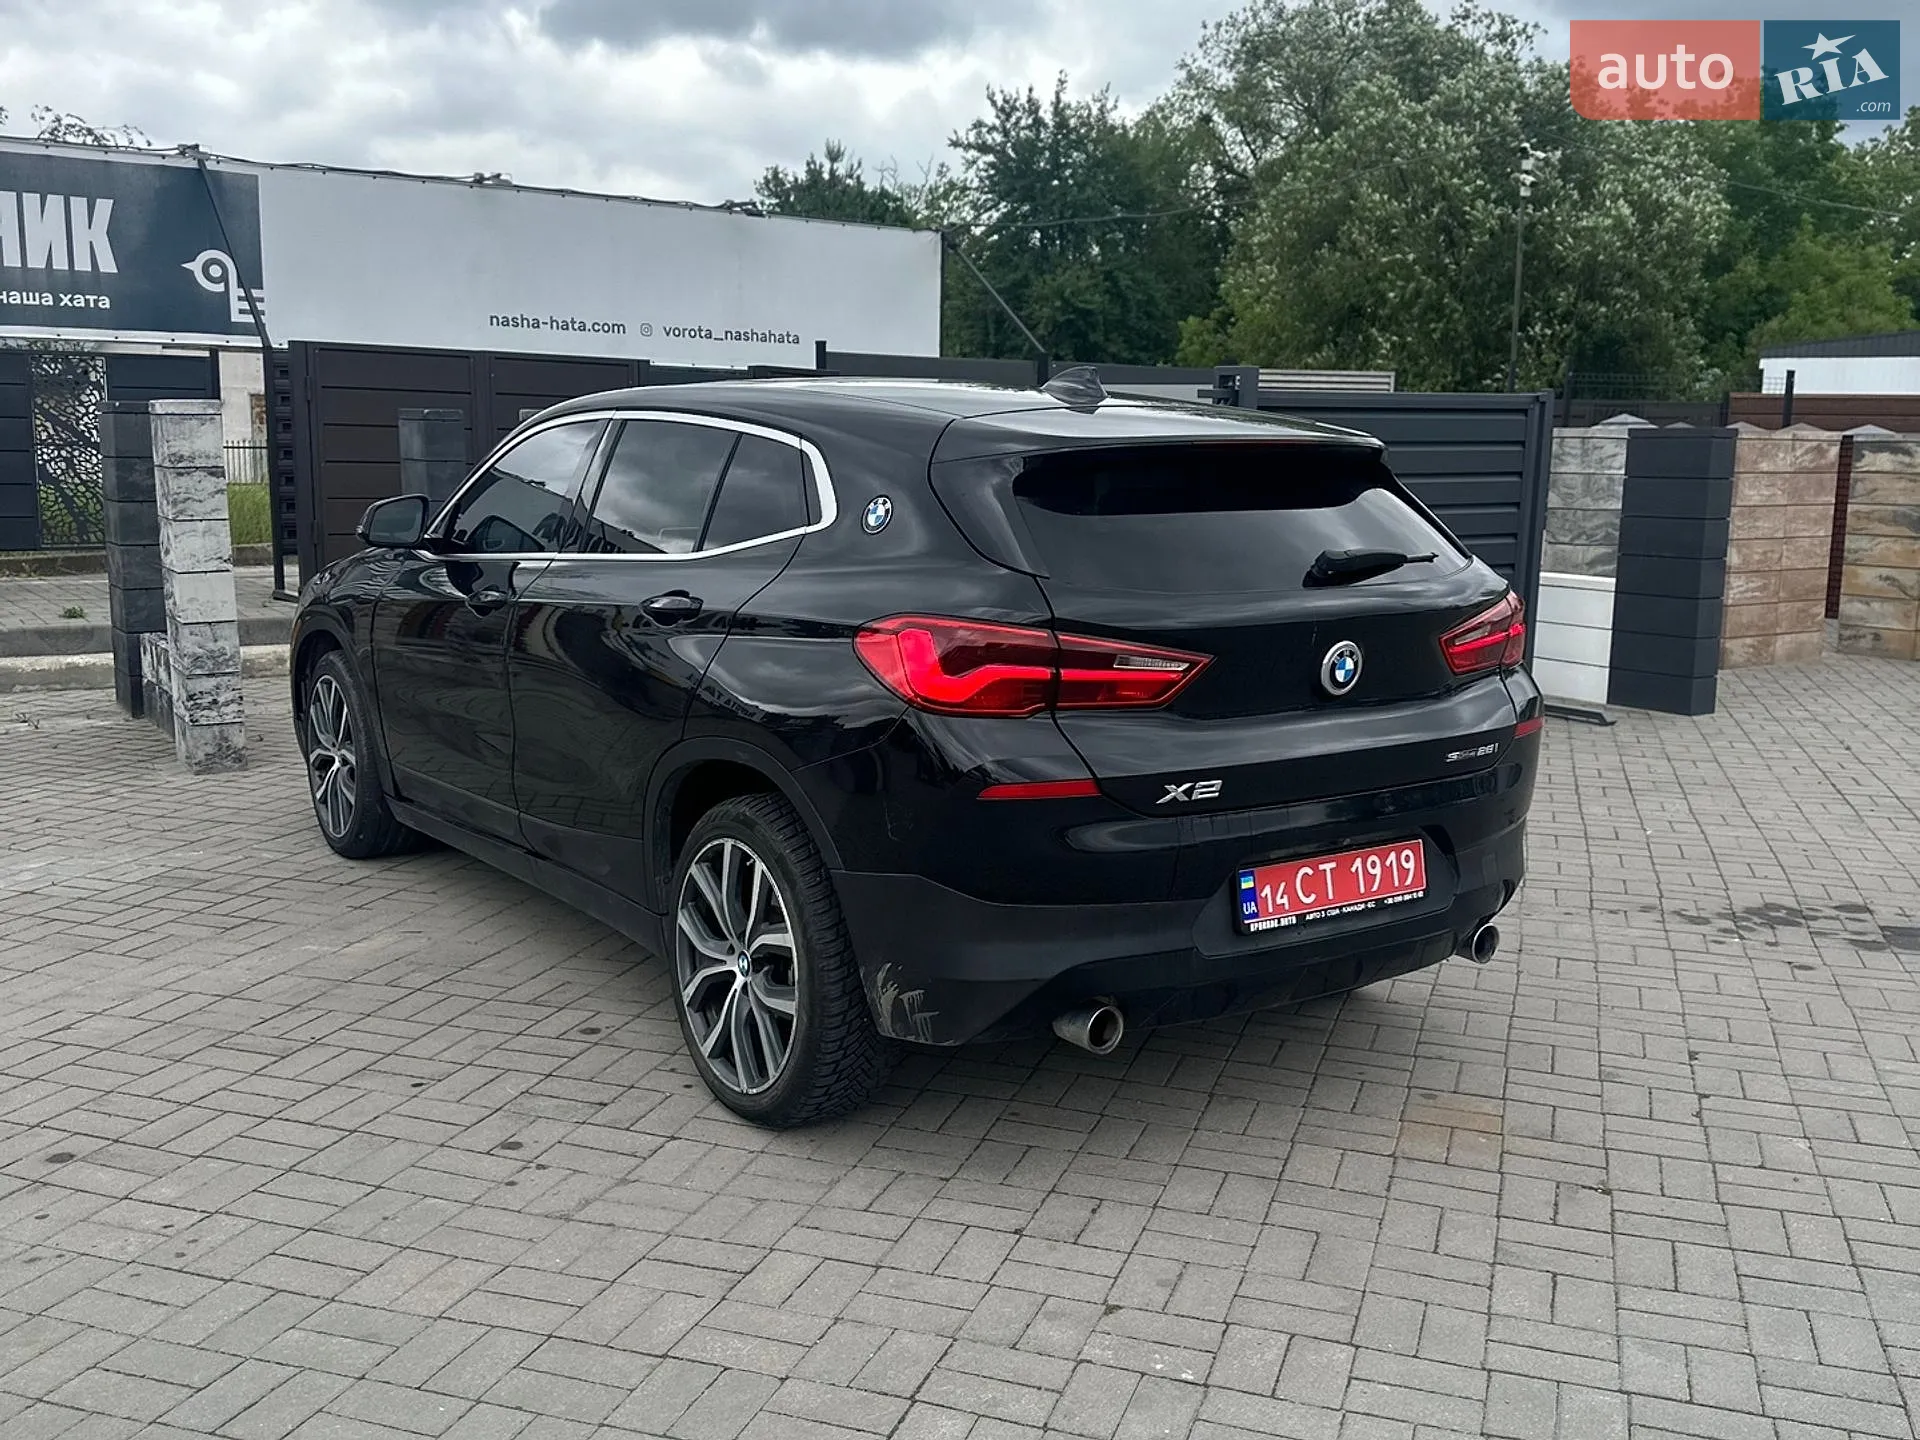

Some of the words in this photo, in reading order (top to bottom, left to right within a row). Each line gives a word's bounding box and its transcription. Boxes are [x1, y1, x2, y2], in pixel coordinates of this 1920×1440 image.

[59, 293, 111, 309] хата
[489, 313, 627, 335] nasha-hata.com
[662, 325, 800, 345] vorota_nashahata
[1156, 779, 1223, 804] X2
[1350, 849, 1415, 894] 1919
[1243, 901, 1258, 915] UA
